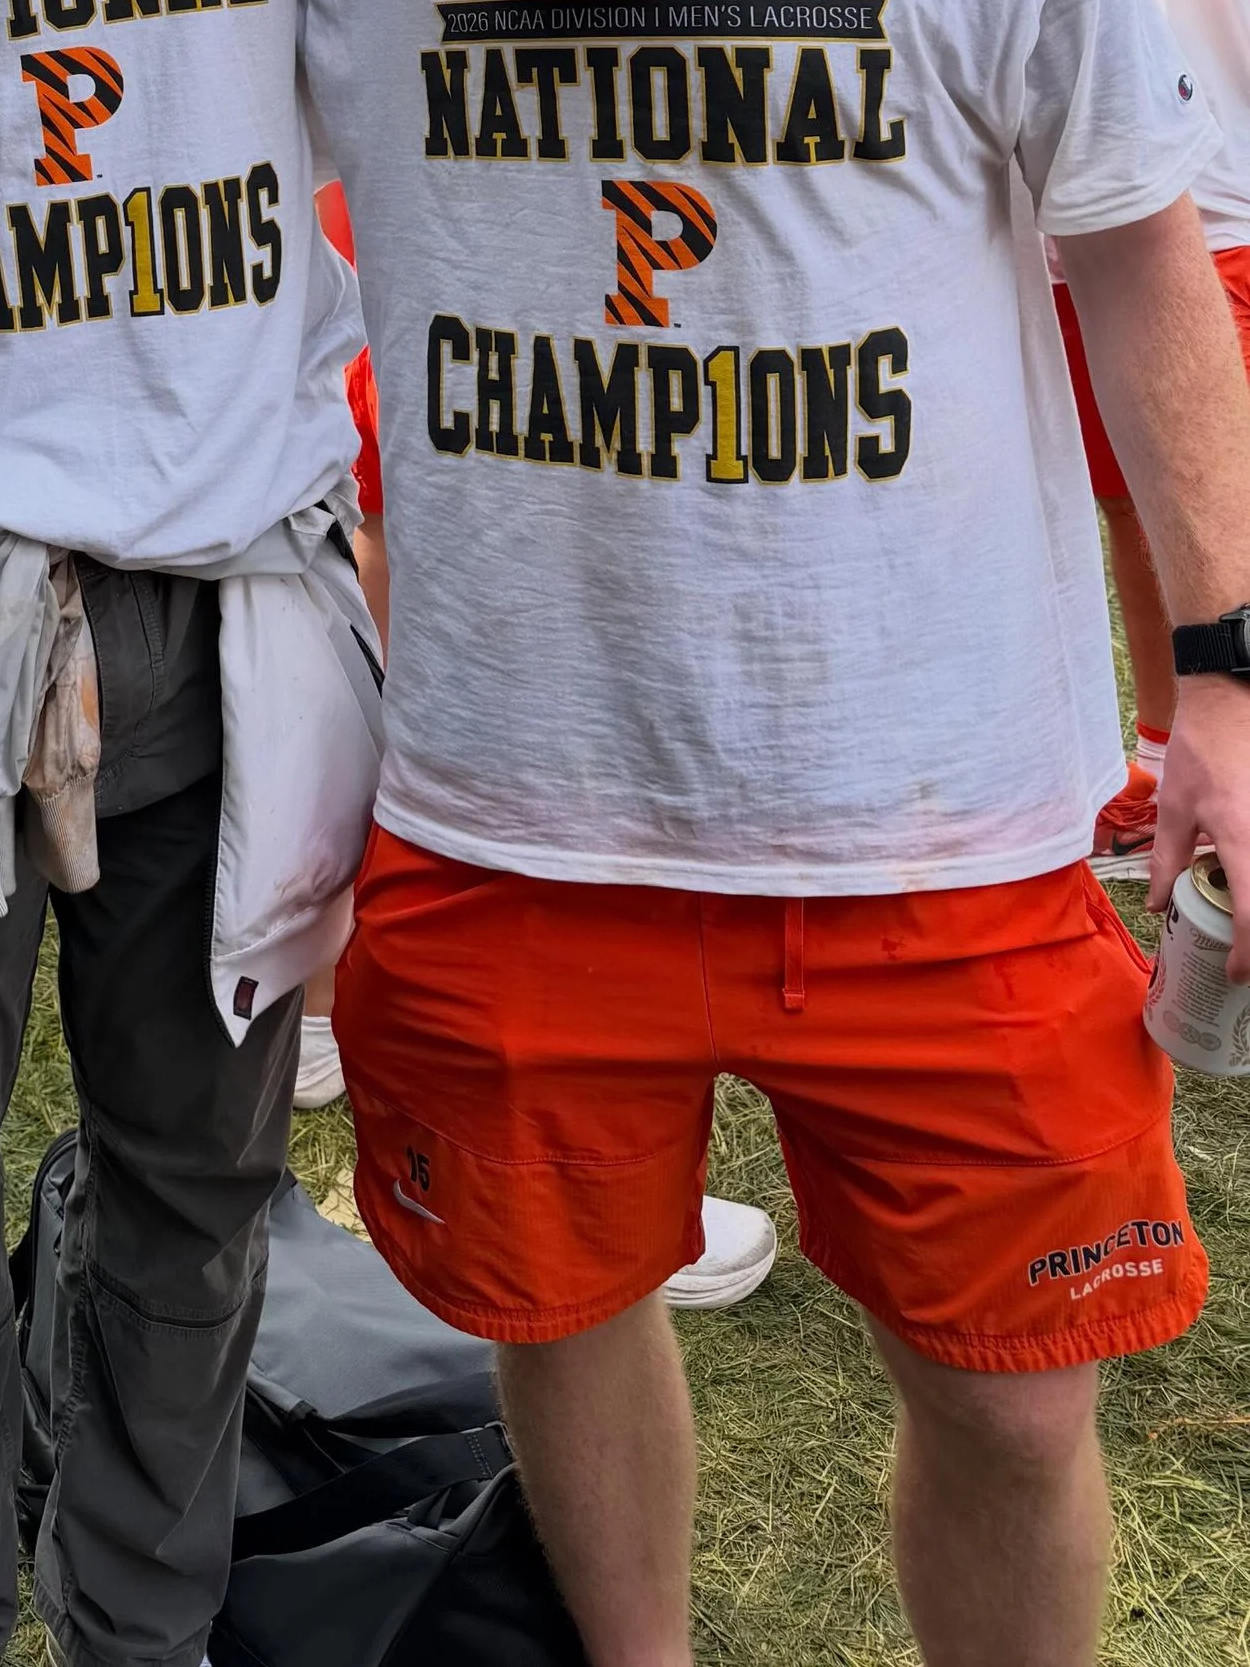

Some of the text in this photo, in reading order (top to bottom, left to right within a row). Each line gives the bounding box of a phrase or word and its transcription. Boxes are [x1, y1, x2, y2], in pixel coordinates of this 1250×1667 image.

[447, 10, 489, 34] 2026
[494, 7, 545, 31] NCAA
[552, 6, 645, 30] DIVISION
[669, 4, 742, 29] MEN'S
[750, 5, 873, 30] LACROSSE
[20, 45, 125, 187] P
[420, 45, 908, 166] NATIONAL
[601, 179, 718, 327] P
[1028, 1219, 1185, 1287] PRINCETON
[1070, 1259, 1163, 1300] LACROSSE
